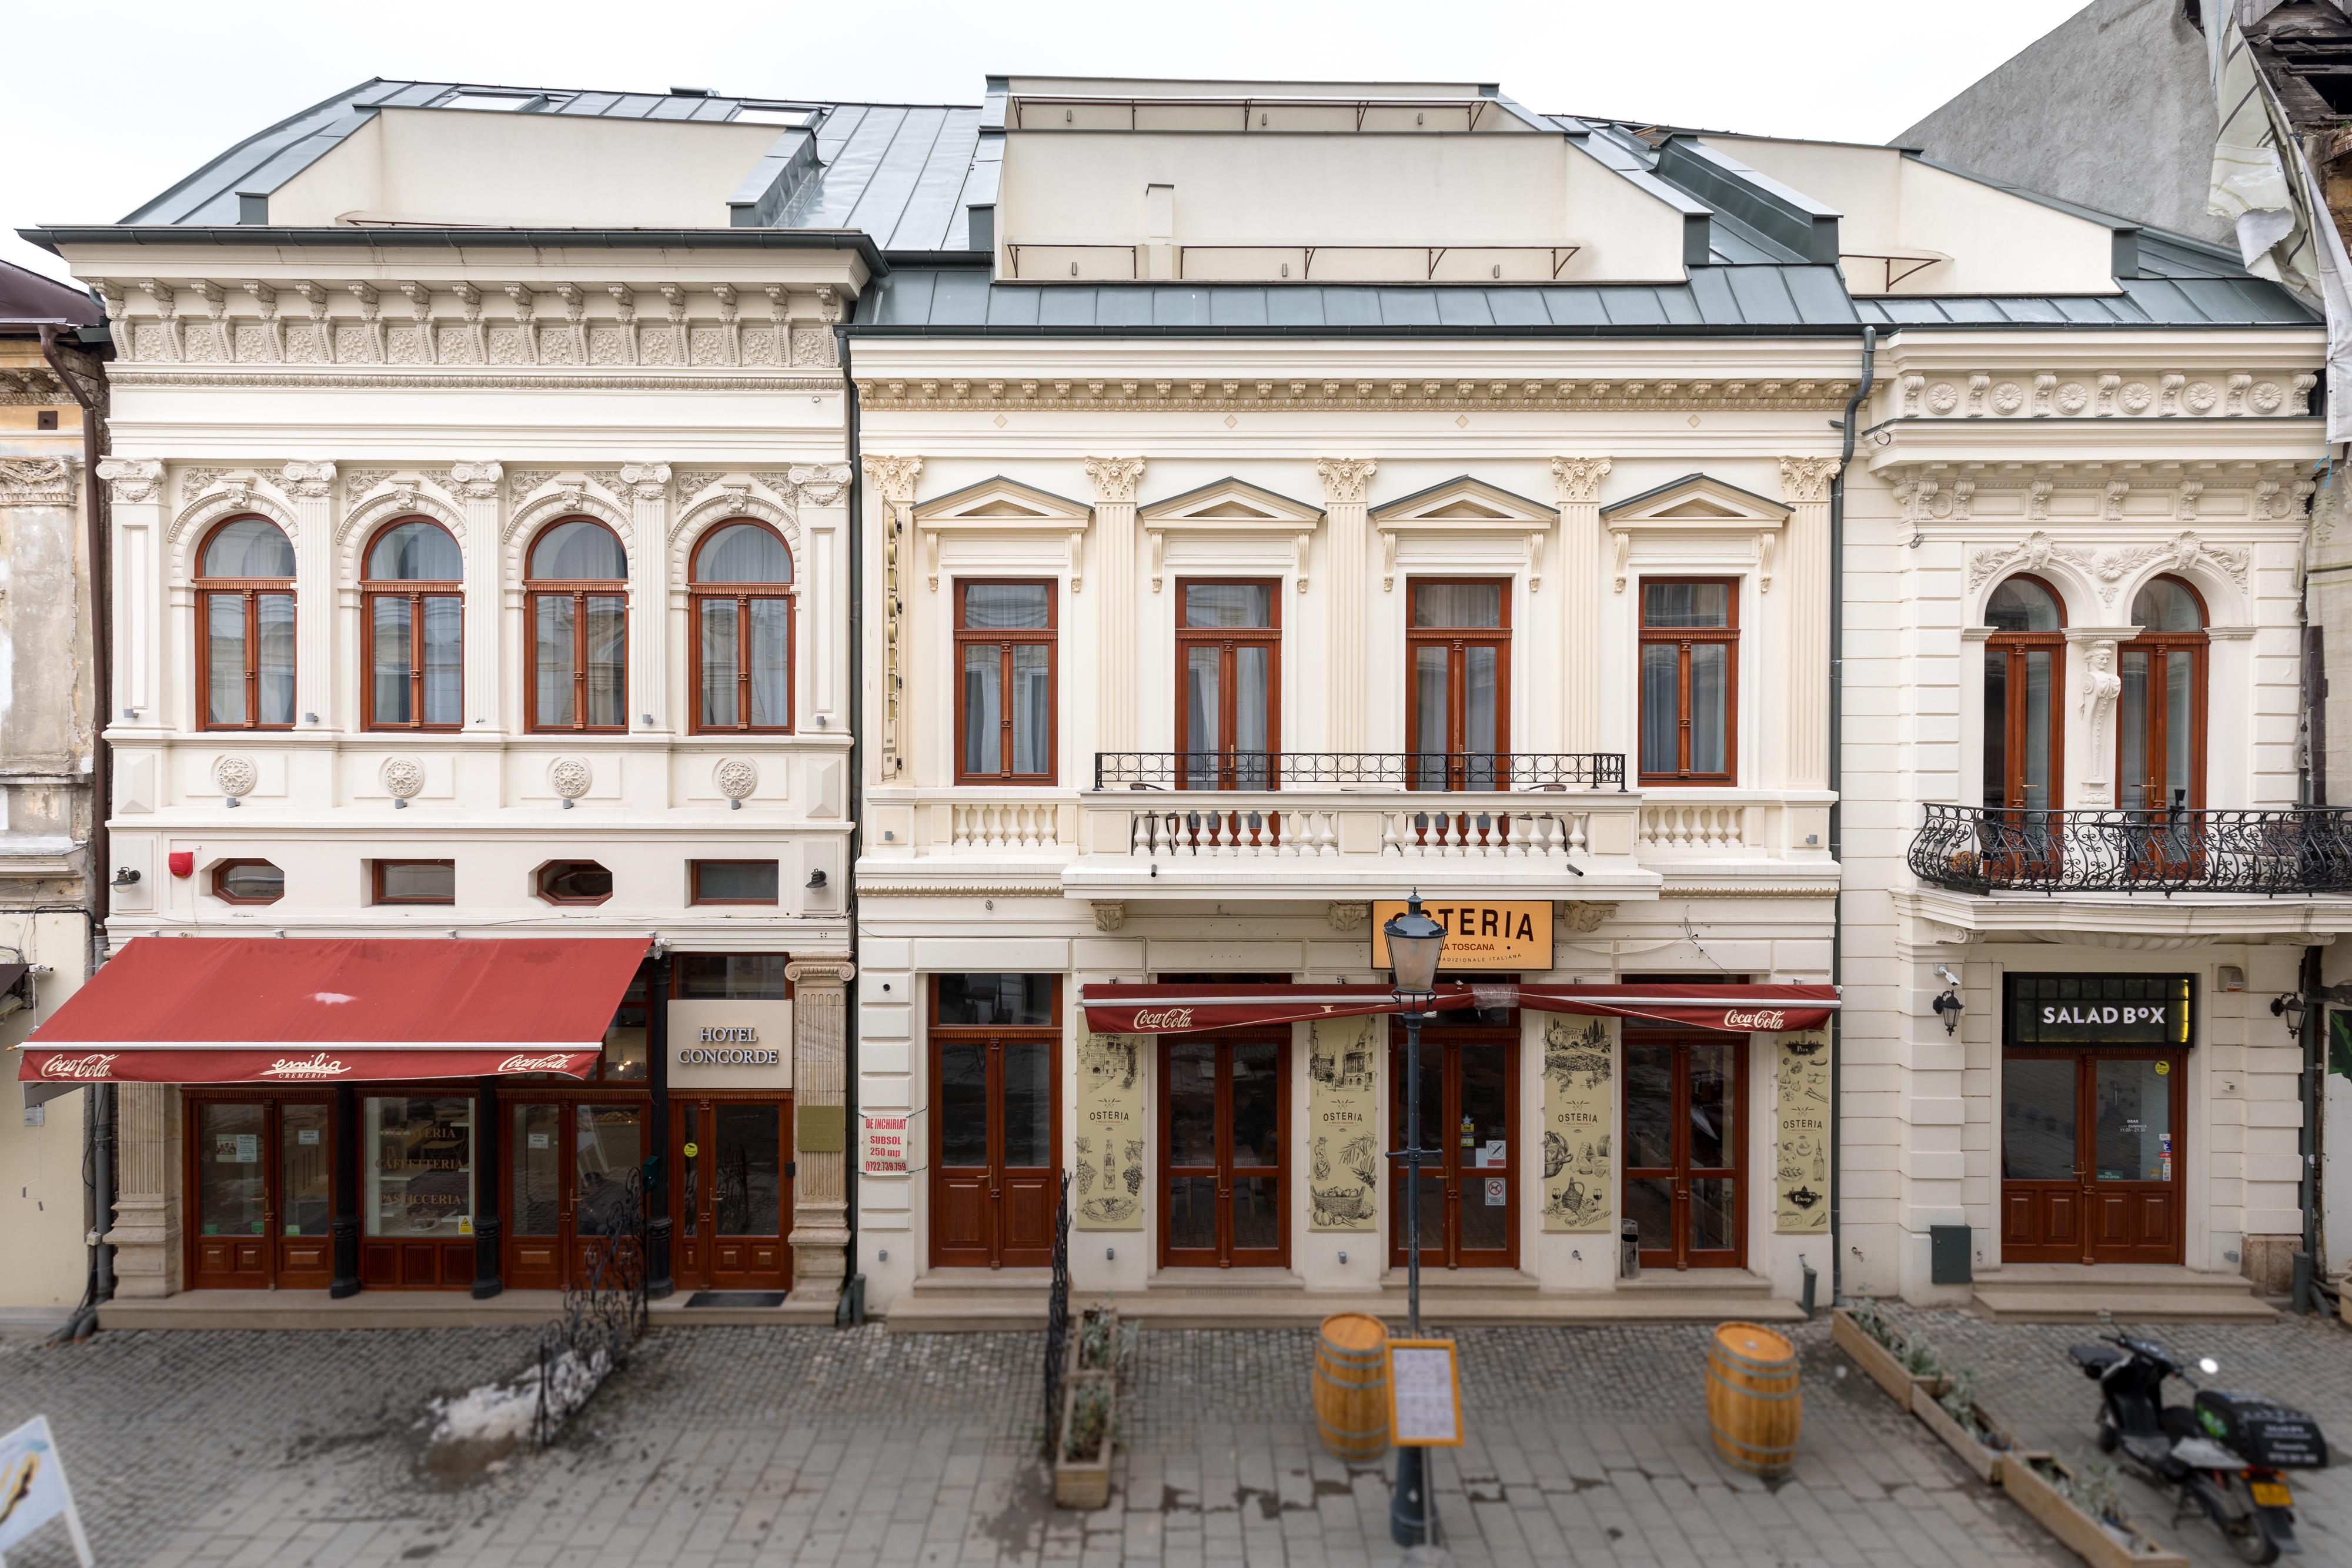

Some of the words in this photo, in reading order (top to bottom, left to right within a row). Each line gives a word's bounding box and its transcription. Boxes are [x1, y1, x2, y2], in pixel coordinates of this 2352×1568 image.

[1392, 908, 1534, 942] TERIA
[1134, 1008, 1194, 1029] Coca-Cola
[1724, 1009, 1785, 1029] Coca-Cola
[2043, 1007, 2119, 1024] SALAD
[699, 1028, 757, 1042] HOTEL
[271, 1052, 352, 1072] emilia
[678, 1049, 779, 1064] CONCORDE
[41, 1054, 120, 1077] Coca-Cola
[498, 1054, 579, 1071] Coca-Cola
[1090, 1111, 1129, 1121] OSTERIA
[1323, 1112, 1362, 1122] OSTERIA
[1558, 1114, 1598, 1122] OSTERIA
[866, 1119, 874, 1129] DE
[875, 1118, 907, 1129] INCHIRIAT
[1783, 1119, 1822, 1129] OSTERIA
[870, 1135, 901, 1145] SUBSOL
[870, 1147, 885, 1156] 250
[376, 1159, 463, 1169] CAFFETTERIA
[866, 1161, 907, 1171] 0722.739.759
[380, 1195, 462, 1205] PASTICCERIA
